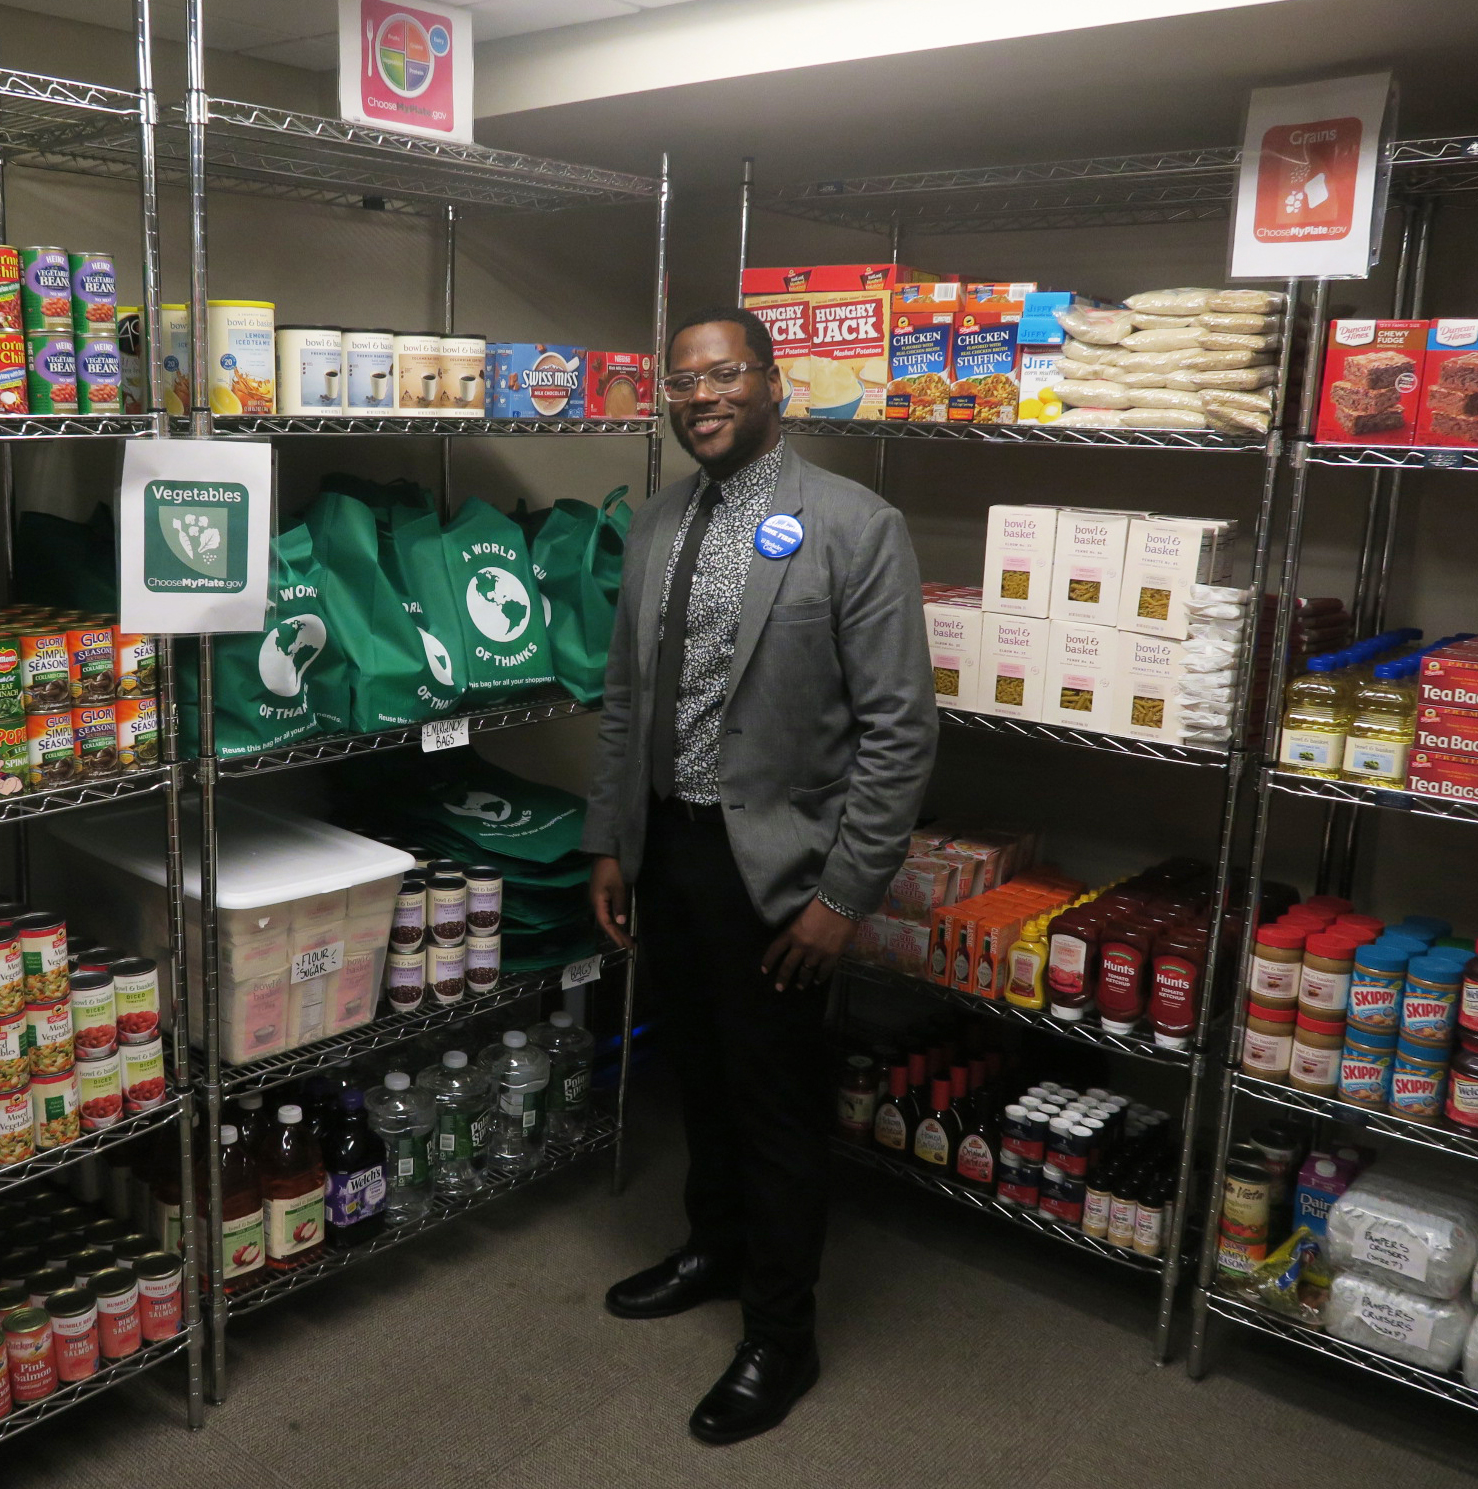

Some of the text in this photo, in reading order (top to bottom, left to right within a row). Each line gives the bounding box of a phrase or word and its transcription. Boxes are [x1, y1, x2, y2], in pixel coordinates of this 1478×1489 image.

[1289, 129, 1337, 145] Grains
[1256, 225, 1347, 238] ChooseMyPlate.gov
[815, 303, 876, 322] HUNGRY
[813, 317, 879, 344] JACK
[1339, 325, 1372, 335] Duncan
[1343, 333, 1369, 341] Hines
[893, 330, 942, 346] CHICKEN
[957, 330, 1009, 346] CHICKEN
[833, 347, 882, 357] Mashed Potatoes
[893, 352, 943, 367] STUFFING
[957, 352, 1011, 367] STUFFING
[907, 363, 928, 375] MIX
[978, 363, 995, 375] MIX
[521, 370, 578, 389] SWISS MISS
[152, 486, 242, 503] Vegetables
[1004, 519, 1026, 528] bowl
[1075, 525, 1098, 535] bowl
[1003, 528, 1036, 539] basket
[1074, 534, 1106, 546] basket
[1146, 533, 1170, 545] bowl
[471, 543, 516, 561] WORLD
[1144, 543, 1179, 556] basket
[147, 577, 243, 588] ChooseMyPlate.gov
[475, 642, 538, 667] OF THANKS
[480, 681, 491, 689] bag
[510, 678, 524, 686] your
[259, 704, 273, 719] OF
[426, 719, 462, 737] EMERGENCY
[436, 733, 455, 748] BAGS
[1418, 731, 1448, 748] Tea
[222, 747, 246, 755] Reuse
[1410, 776, 1439, 793] Tea
[302, 948, 329, 966] FLOUR
[300, 963, 327, 979] SUGAR
[570, 962, 592, 980] BAGS
[1107, 973, 1129, 982] TOMATO
[1106, 978, 1131, 987] KETCHUP
[1354, 991, 1395, 1006] SKIPPY
[1406, 1002, 1447, 1018] SKIPPY
[6, 1111, 28, 1122] Mixed
[350, 1168, 382, 1191] Welch's
[1364, 1231, 1410, 1253] PAMPERS
[1361, 1296, 1415, 1322] PAMPERS
[13, 1367, 52, 1382] Salmon
[20, 1361, 45, 1373] Pink
